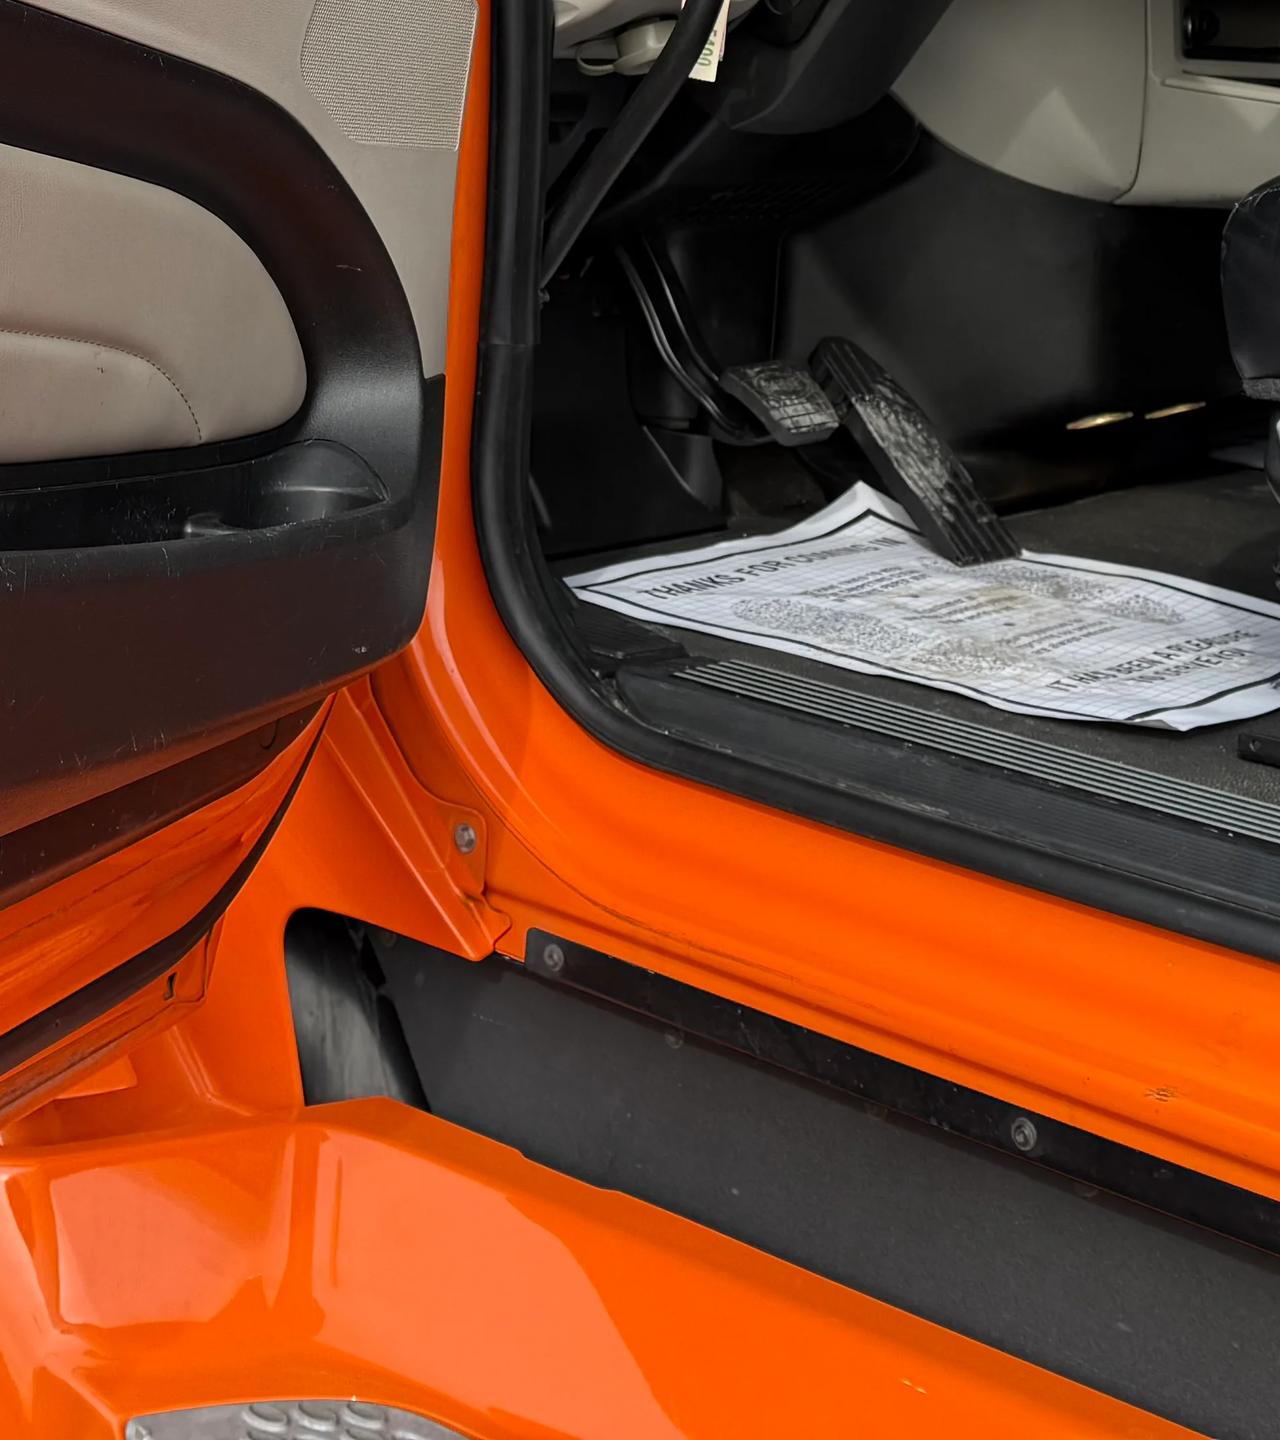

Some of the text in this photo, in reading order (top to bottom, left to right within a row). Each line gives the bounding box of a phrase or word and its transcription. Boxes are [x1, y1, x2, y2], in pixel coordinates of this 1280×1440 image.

[639, 574, 746, 599] THANKS
[735, 560, 796, 578] FOR
[784, 544, 879, 564] COMING
